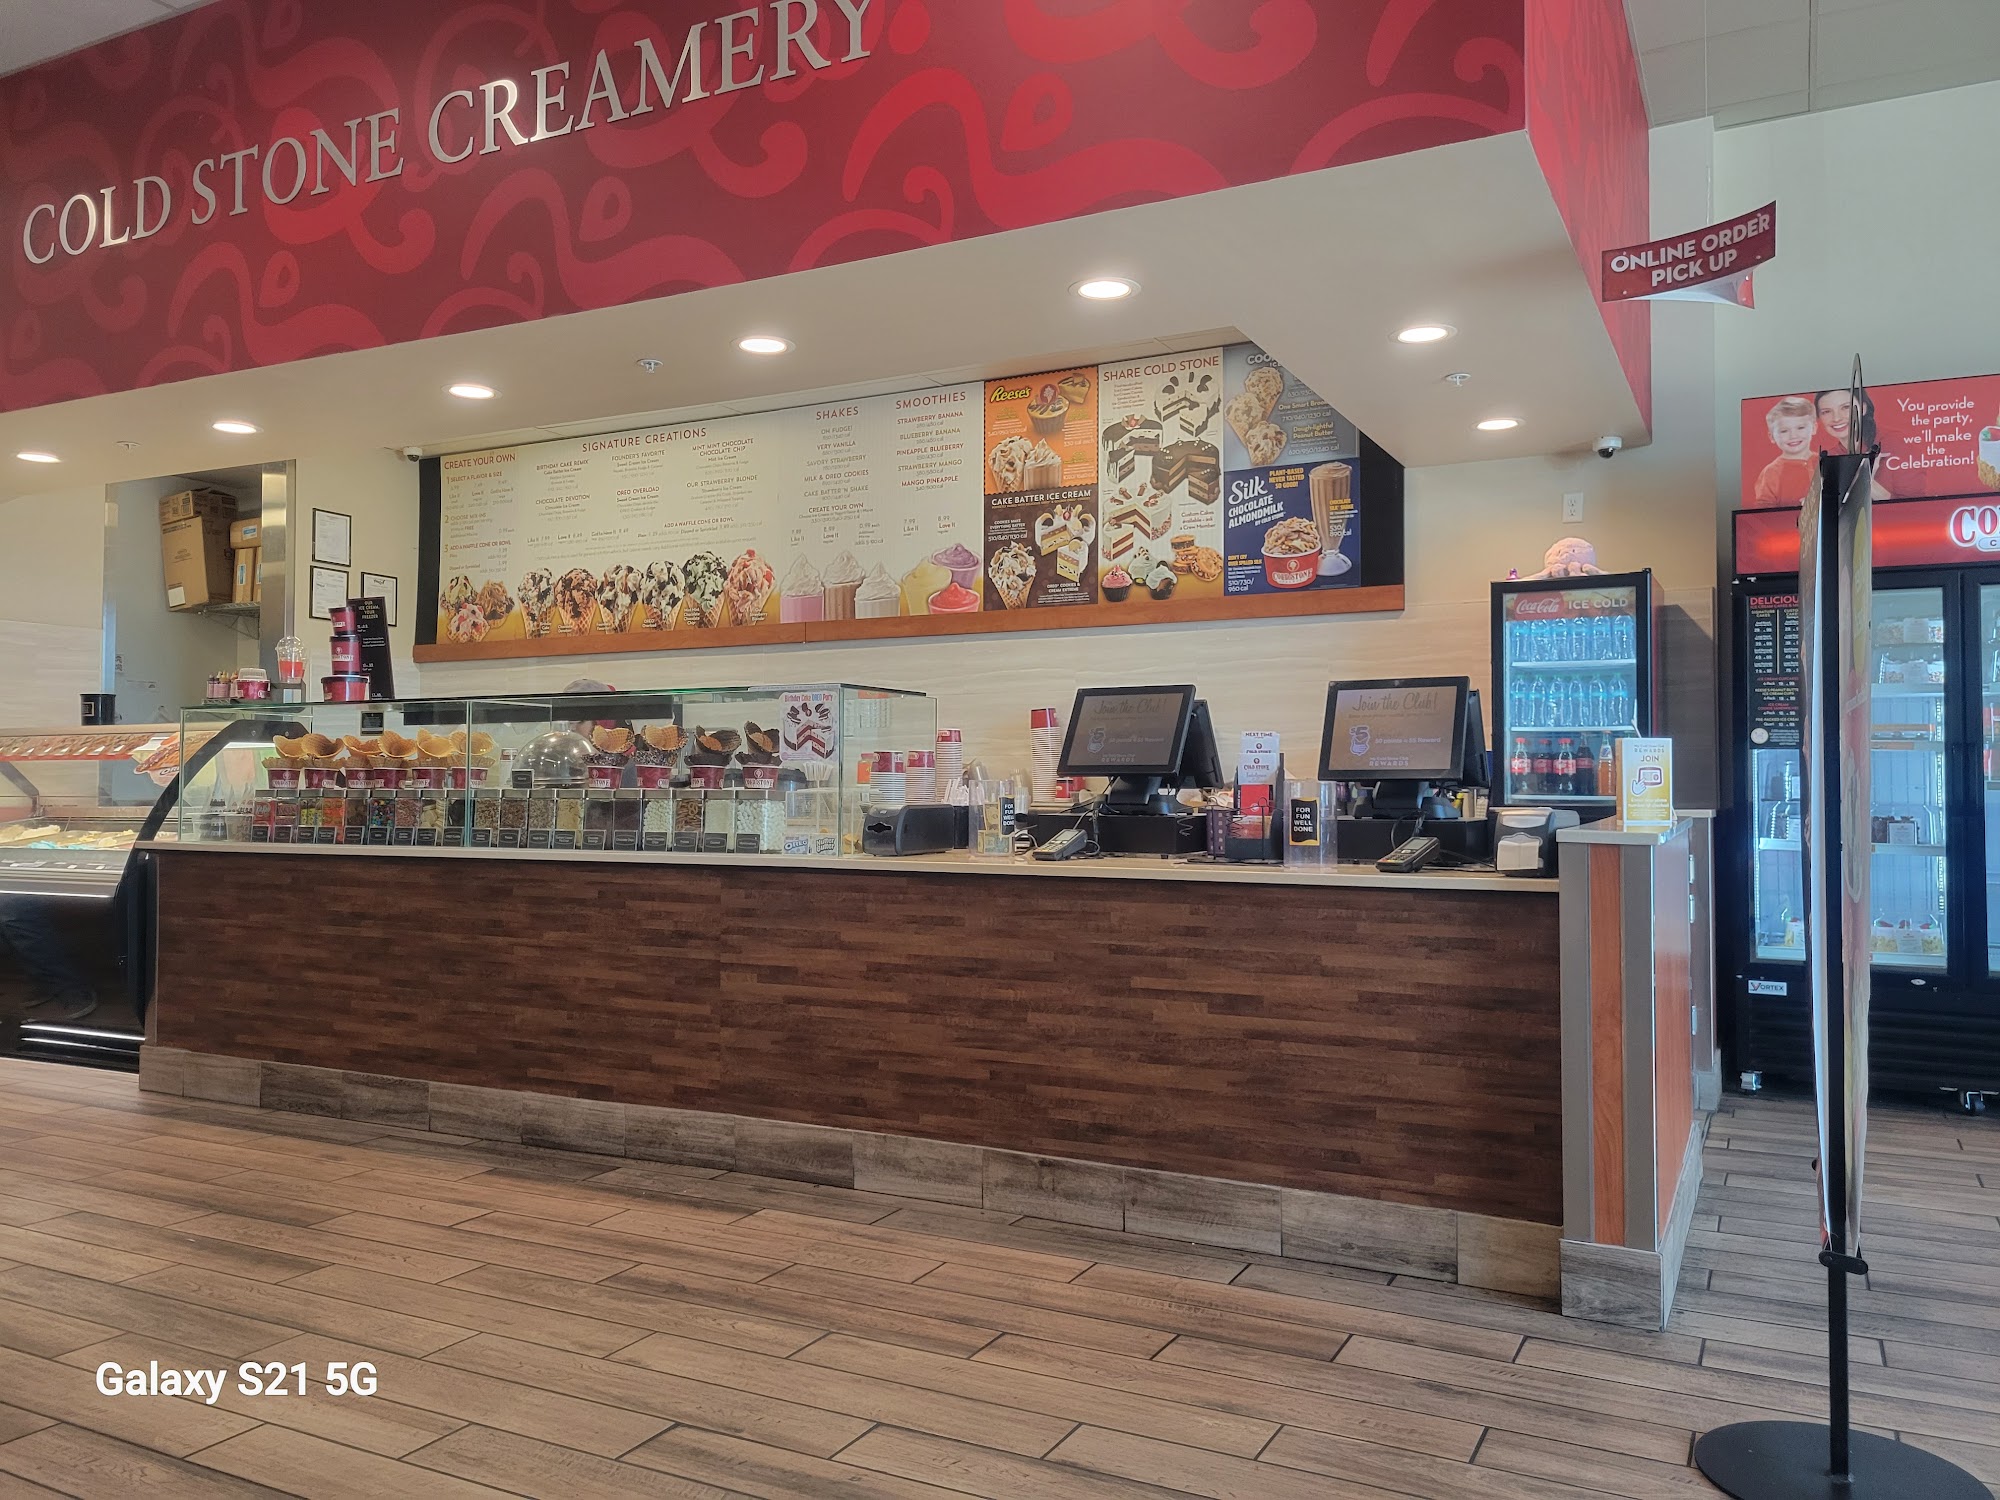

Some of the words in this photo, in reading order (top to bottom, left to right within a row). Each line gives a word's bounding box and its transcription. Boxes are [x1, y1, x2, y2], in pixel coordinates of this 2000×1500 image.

[23, 175, 172, 265] COLD
[191, 109, 403, 225] STONE
[427, 0, 874, 166] CREAMERY
[1611, 240, 1696, 273] ONLINE
[1702, 214, 1770, 252] ORDER
[1652, 259, 1704, 287] PICK
[1709, 249, 1738, 272] UP
[1103, 367, 1140, 381] SHARE
[1143, 363, 1176, 376] COLD
[1180, 356, 1219, 371] STONE
[896, 391, 966, 410] SMOOTHIES
[991, 387, 1032, 403] Reese's
[1292, 401, 1309, 409] Smart
[1897, 399, 1926, 412] You
[1928, 396, 1975, 414] provide
[816, 406, 859, 420] SHAKES
[897, 415, 936, 425] STRAWBERRY
[938, 411, 963, 420] BANANA
[1911, 415, 1930, 426] the
[1934, 412, 1973, 428] party,
[582, 436, 640, 452] SIGNATURE
[645, 428, 707, 444] CREATIONS
[900, 431, 933, 440] BLUEBERRY
[935, 428, 960, 436] BANANA
[1903, 430, 1932, 444] we'll
[1935, 431, 1972, 443] make
[721, 438, 754, 447] CHOCOLATE
[833, 440, 856, 448] VANILLA
[700, 448, 731, 456] CHOCOLATE
[896, 447, 928, 456] PINEAPPLE
[930, 443, 964, 452] BLUEBERRY
[1927, 445, 1946, 455] the
[444, 459, 472, 469] CREATE
[473, 456, 494, 466] YOUR
[496, 453, 516, 463] OWN
[611, 453, 640, 462] FOUNDER'S
[641, 450, 665, 458] FAVORITE
[831, 455, 866, 464] STRAWBERRY
[1886, 451, 1975, 471] Celebration!
[536, 463, 559, 471] BIRTHDAY
[898, 462, 937, 471] STRAWBERRY
[939, 459, 962, 467] MANGO
[844, 470, 869, 478] COOKIES
[1269, 468, 1304, 477] PLANT-BASED
[1286, 474, 1305, 482] TASTED
[700, 478, 734, 487] STRAWBERRY
[902, 479, 925, 487] MANGO
[926, 476, 958, 484] PINEAPPLE
[1228, 475, 1268, 505] Silk
[535, 497, 564, 505] CHOCOLATE
[565, 494, 590, 502] DEVOTION
[992, 498, 1013, 506] CAKE
[1014, 494, 1044, 503] BATTER
[1047, 492, 1060, 500] ICE
[1061, 490, 1091, 499] CREAM
[1228, 495, 1274, 518] CHOCOLATE
[1228, 502, 1284, 529] ALMONDMILK
[444, 544, 449, 552] 3
[1568, 600, 1589, 610] ICE
[1593, 598, 1628, 608] COLD
[1750, 595, 1799, 605] DELICIOU
[1352, 695, 1380, 711] Join
[1381, 693, 1399, 710] the
[1403, 692, 1438, 710] Club!
[784, 839, 808, 851] OREO
[1750, 982, 1784, 991] VORTEX
